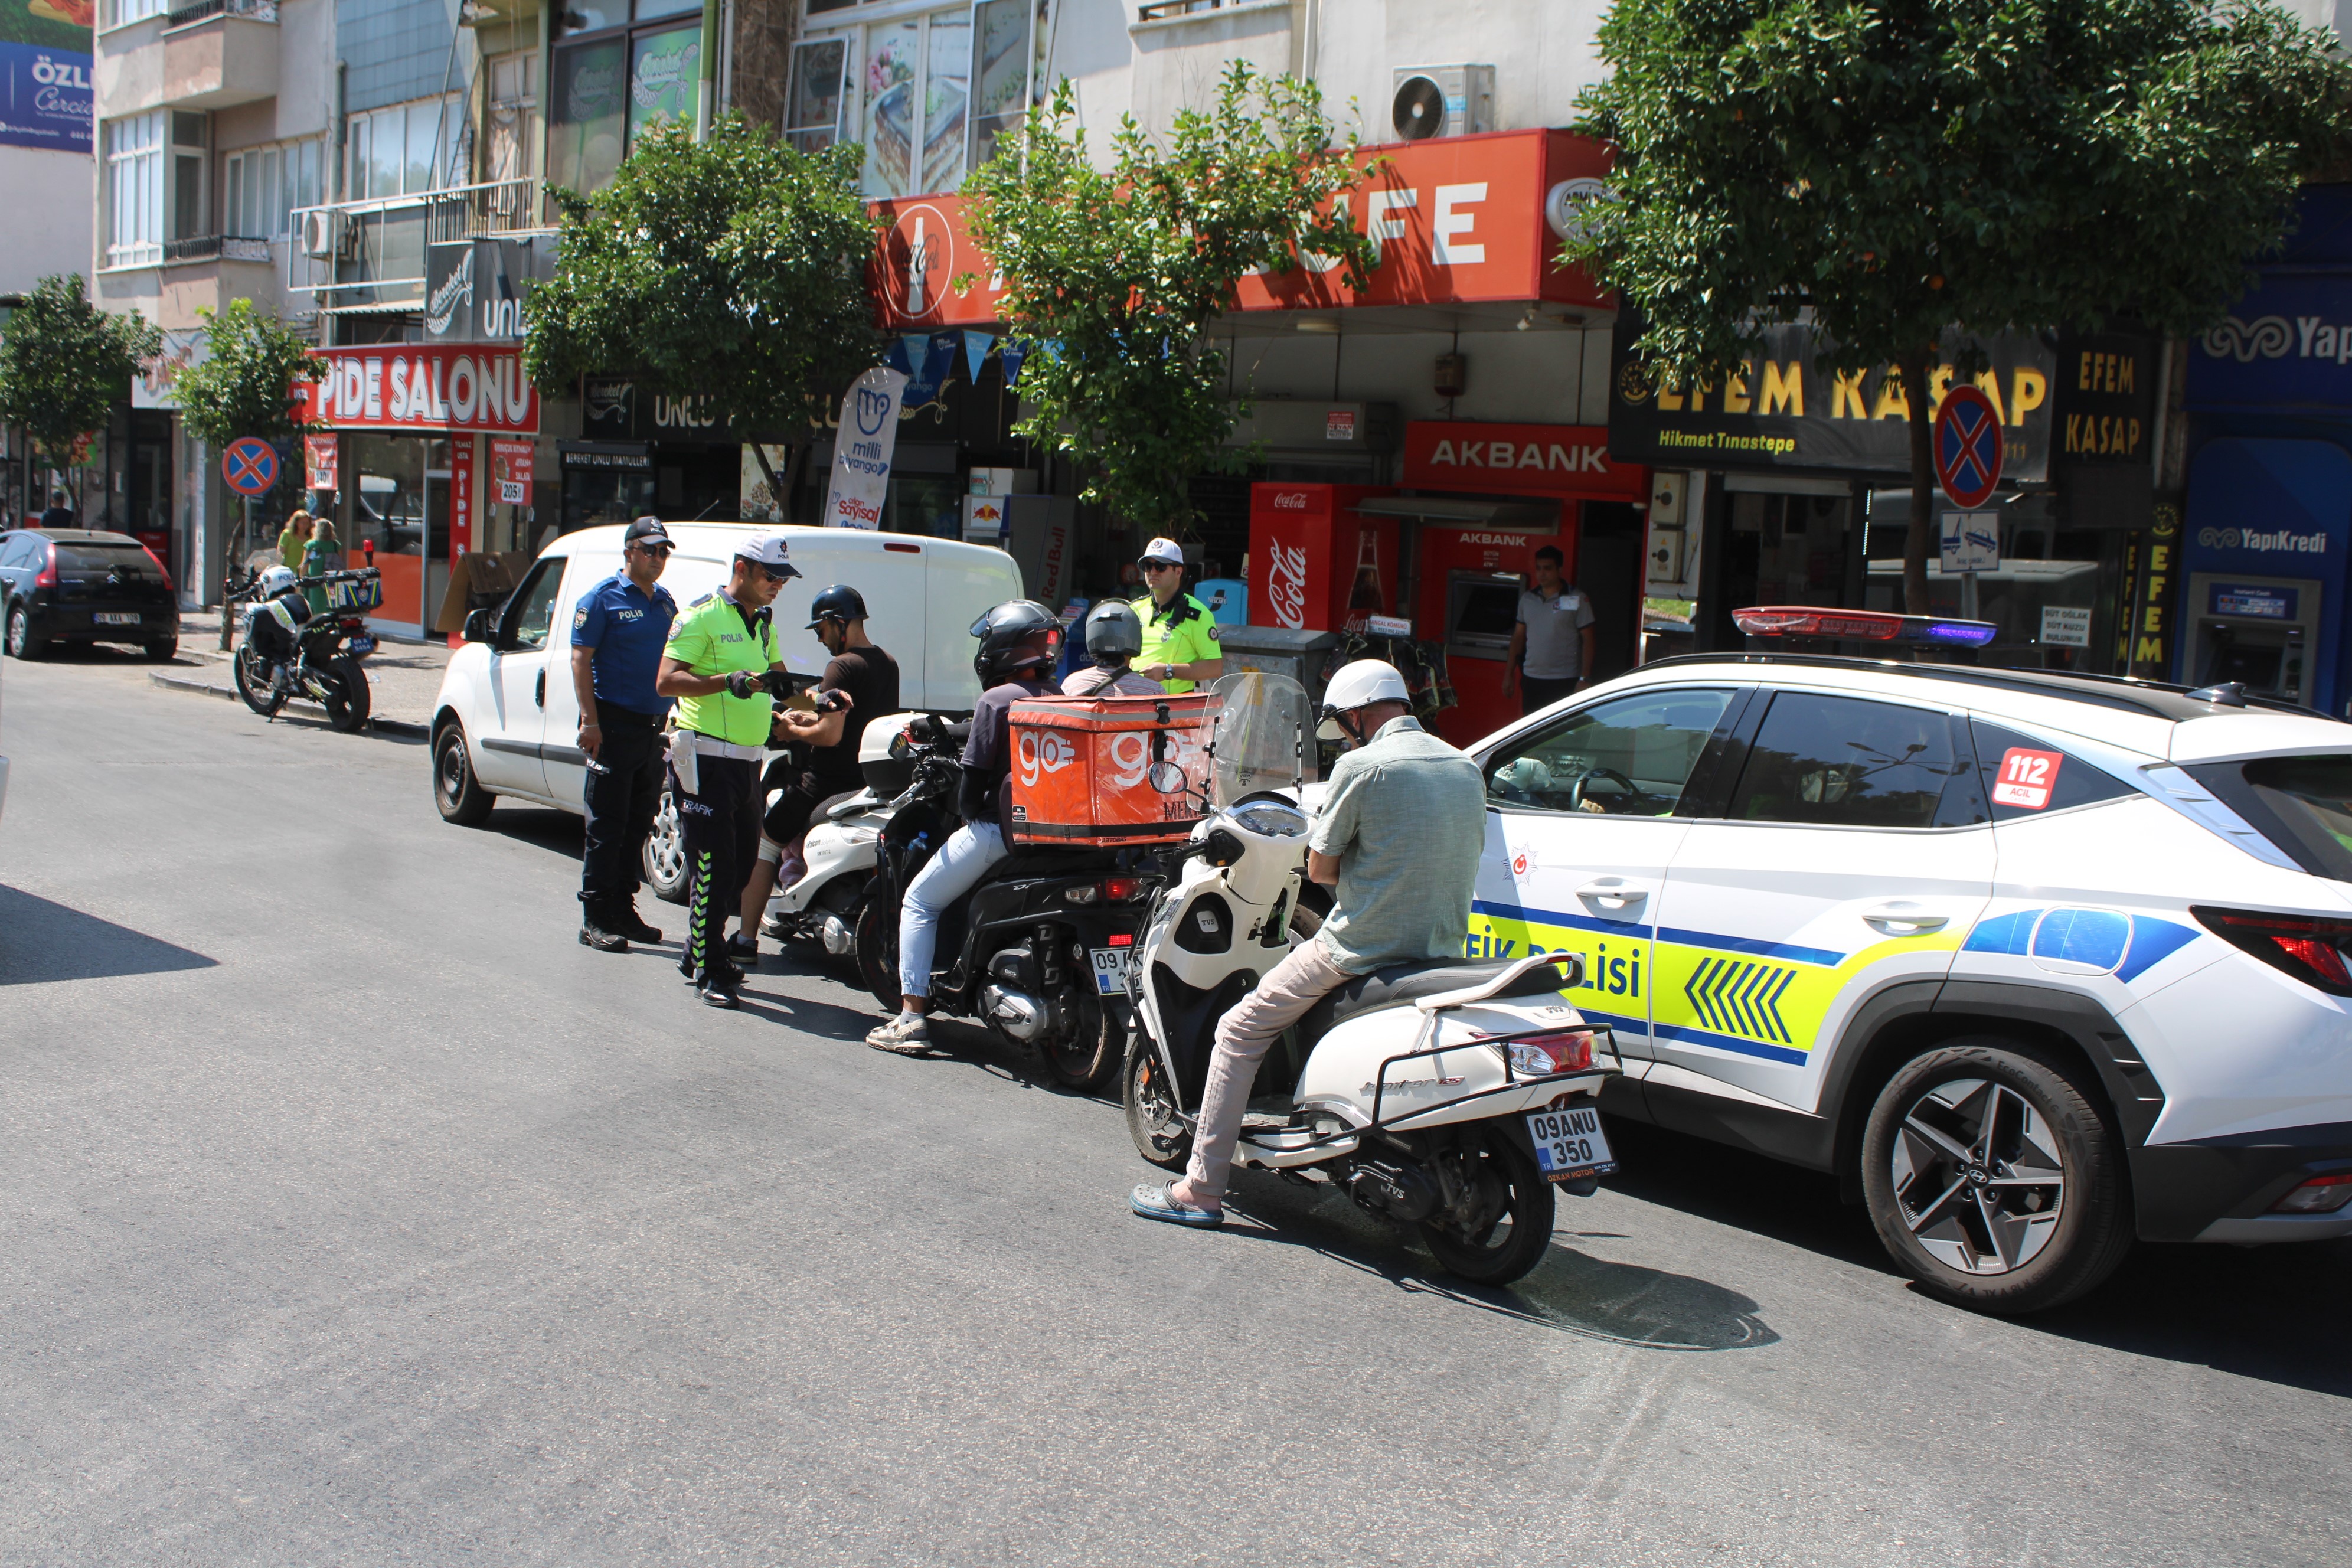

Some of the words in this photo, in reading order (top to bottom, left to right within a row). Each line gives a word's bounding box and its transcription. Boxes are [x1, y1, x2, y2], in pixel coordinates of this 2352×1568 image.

[2079, 351, 2135, 394] EFEM
[316, 354, 383, 420] PİDE
[389, 354, 531, 425] SALONU
[1659, 430, 1713, 447] Hikmet
[1717, 432, 1795, 456] Tınastepe
[2066, 413, 2141, 455] KASAP
[852, 442, 882, 460] milli
[1430, 440, 1608, 473] AKBANK
[1459, 533, 1527, 547] AKBANK
[2242, 528, 2327, 553] YapıKredi
[619, 609, 644, 620] POLİS
[721, 633, 743, 644] POLİS
[2008, 754, 2050, 785] 112
[2010, 788, 2031, 798] ACİL
[1096, 952, 1118, 969] 09
[1534, 1111, 1597, 1141] 09ANU
[1553, 1139, 1593, 1165] 350
[1547, 1172, 1570, 1182] ÖZKAN
[1571, 1168, 1595, 1178] MOTOR
